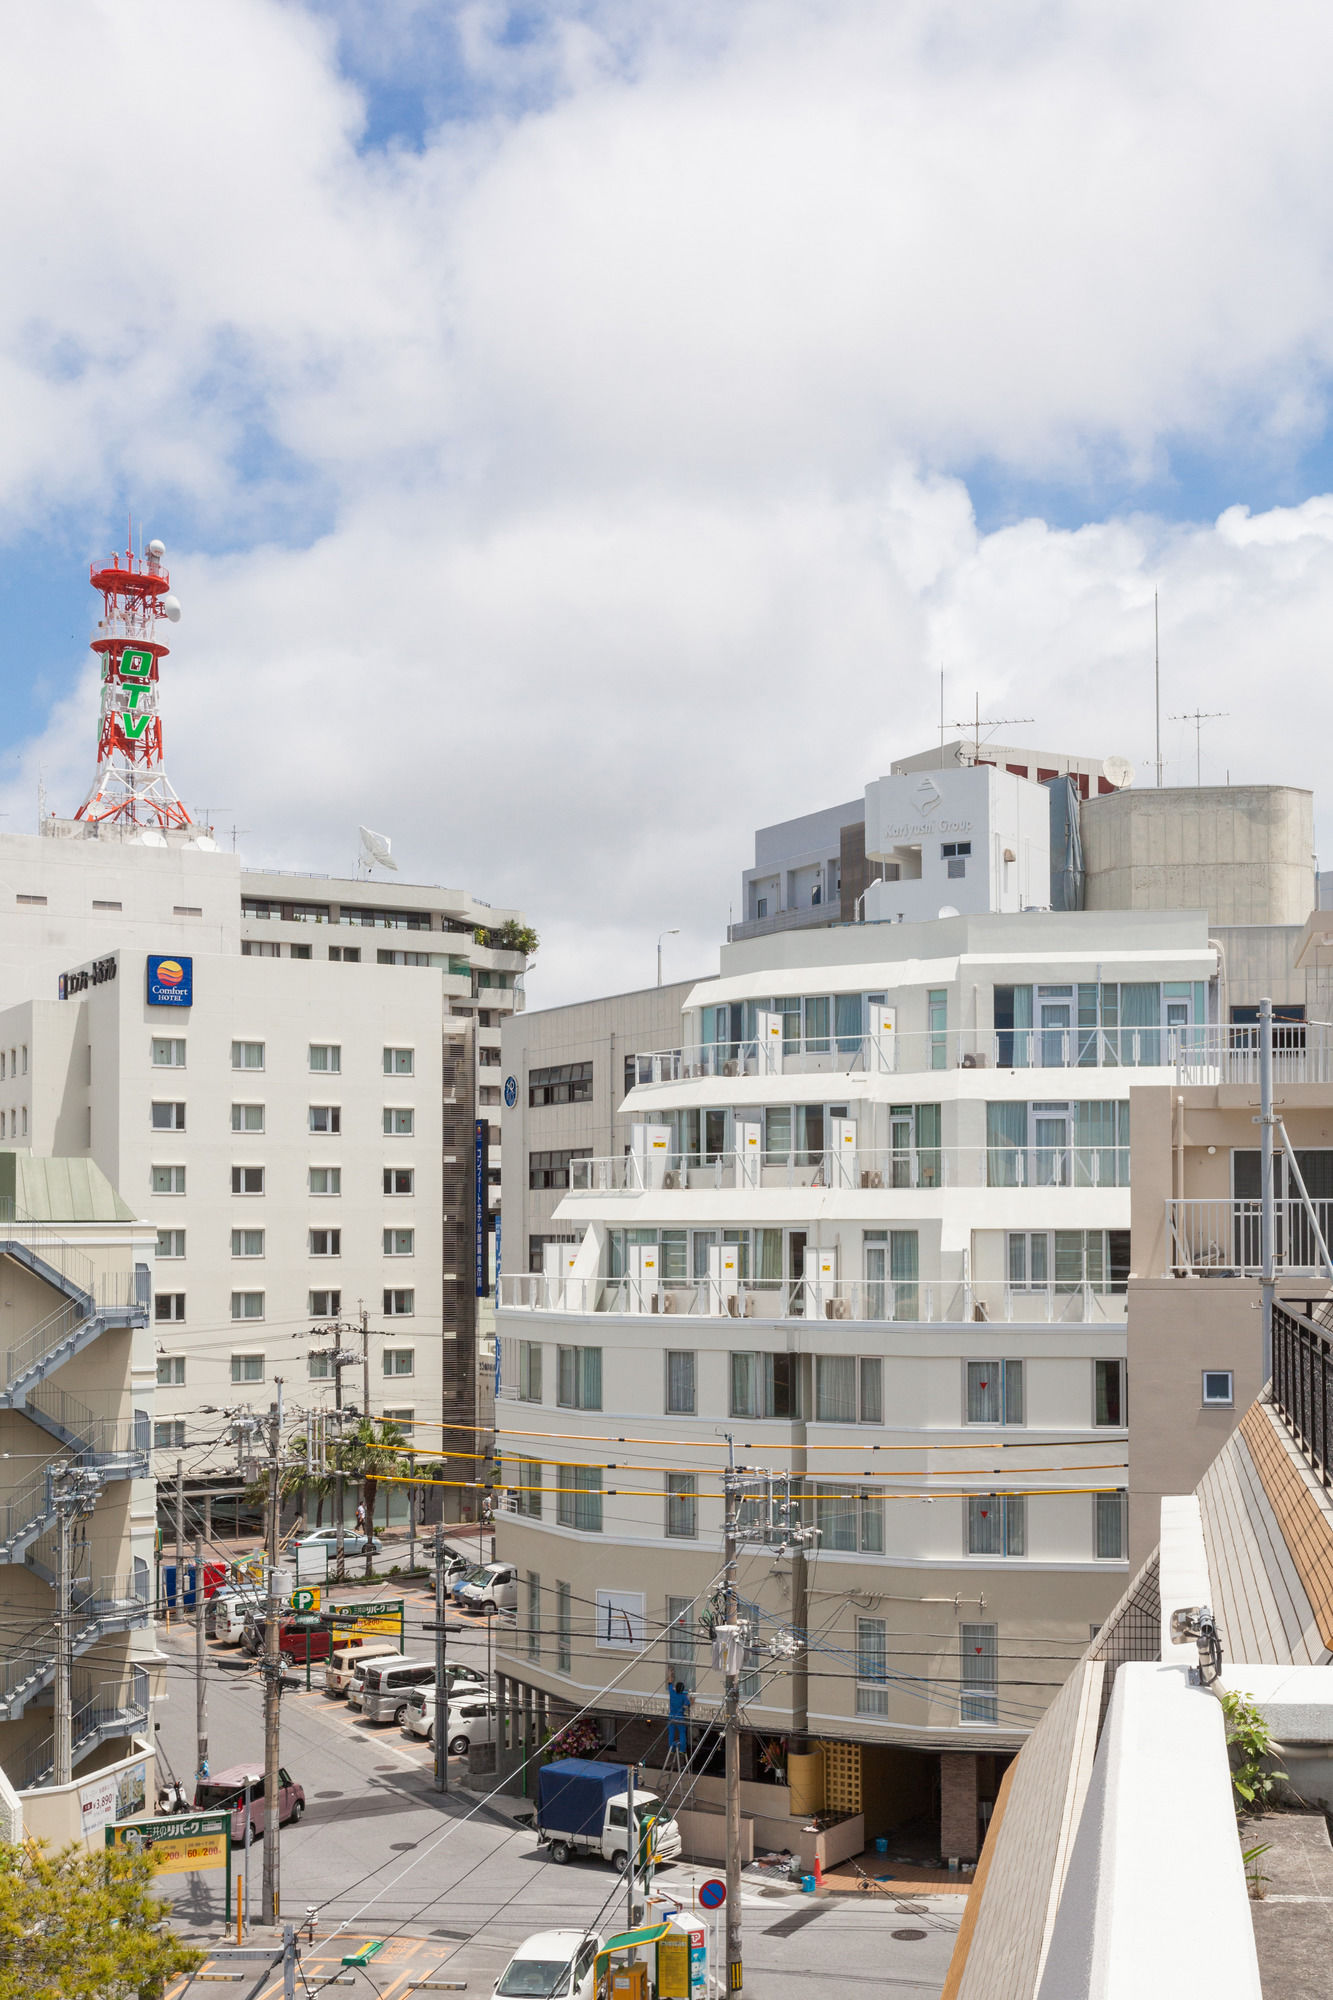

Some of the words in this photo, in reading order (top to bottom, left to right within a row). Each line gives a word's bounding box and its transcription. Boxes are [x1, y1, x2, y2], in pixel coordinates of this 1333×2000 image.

[119, 649, 153, 739] OTV
[938, 820, 973, 834] Group
[152, 985, 188, 996] Comfort
[299, 1592, 312, 1609] P
[146, 1822, 200, 1836] 三井のリパーク
